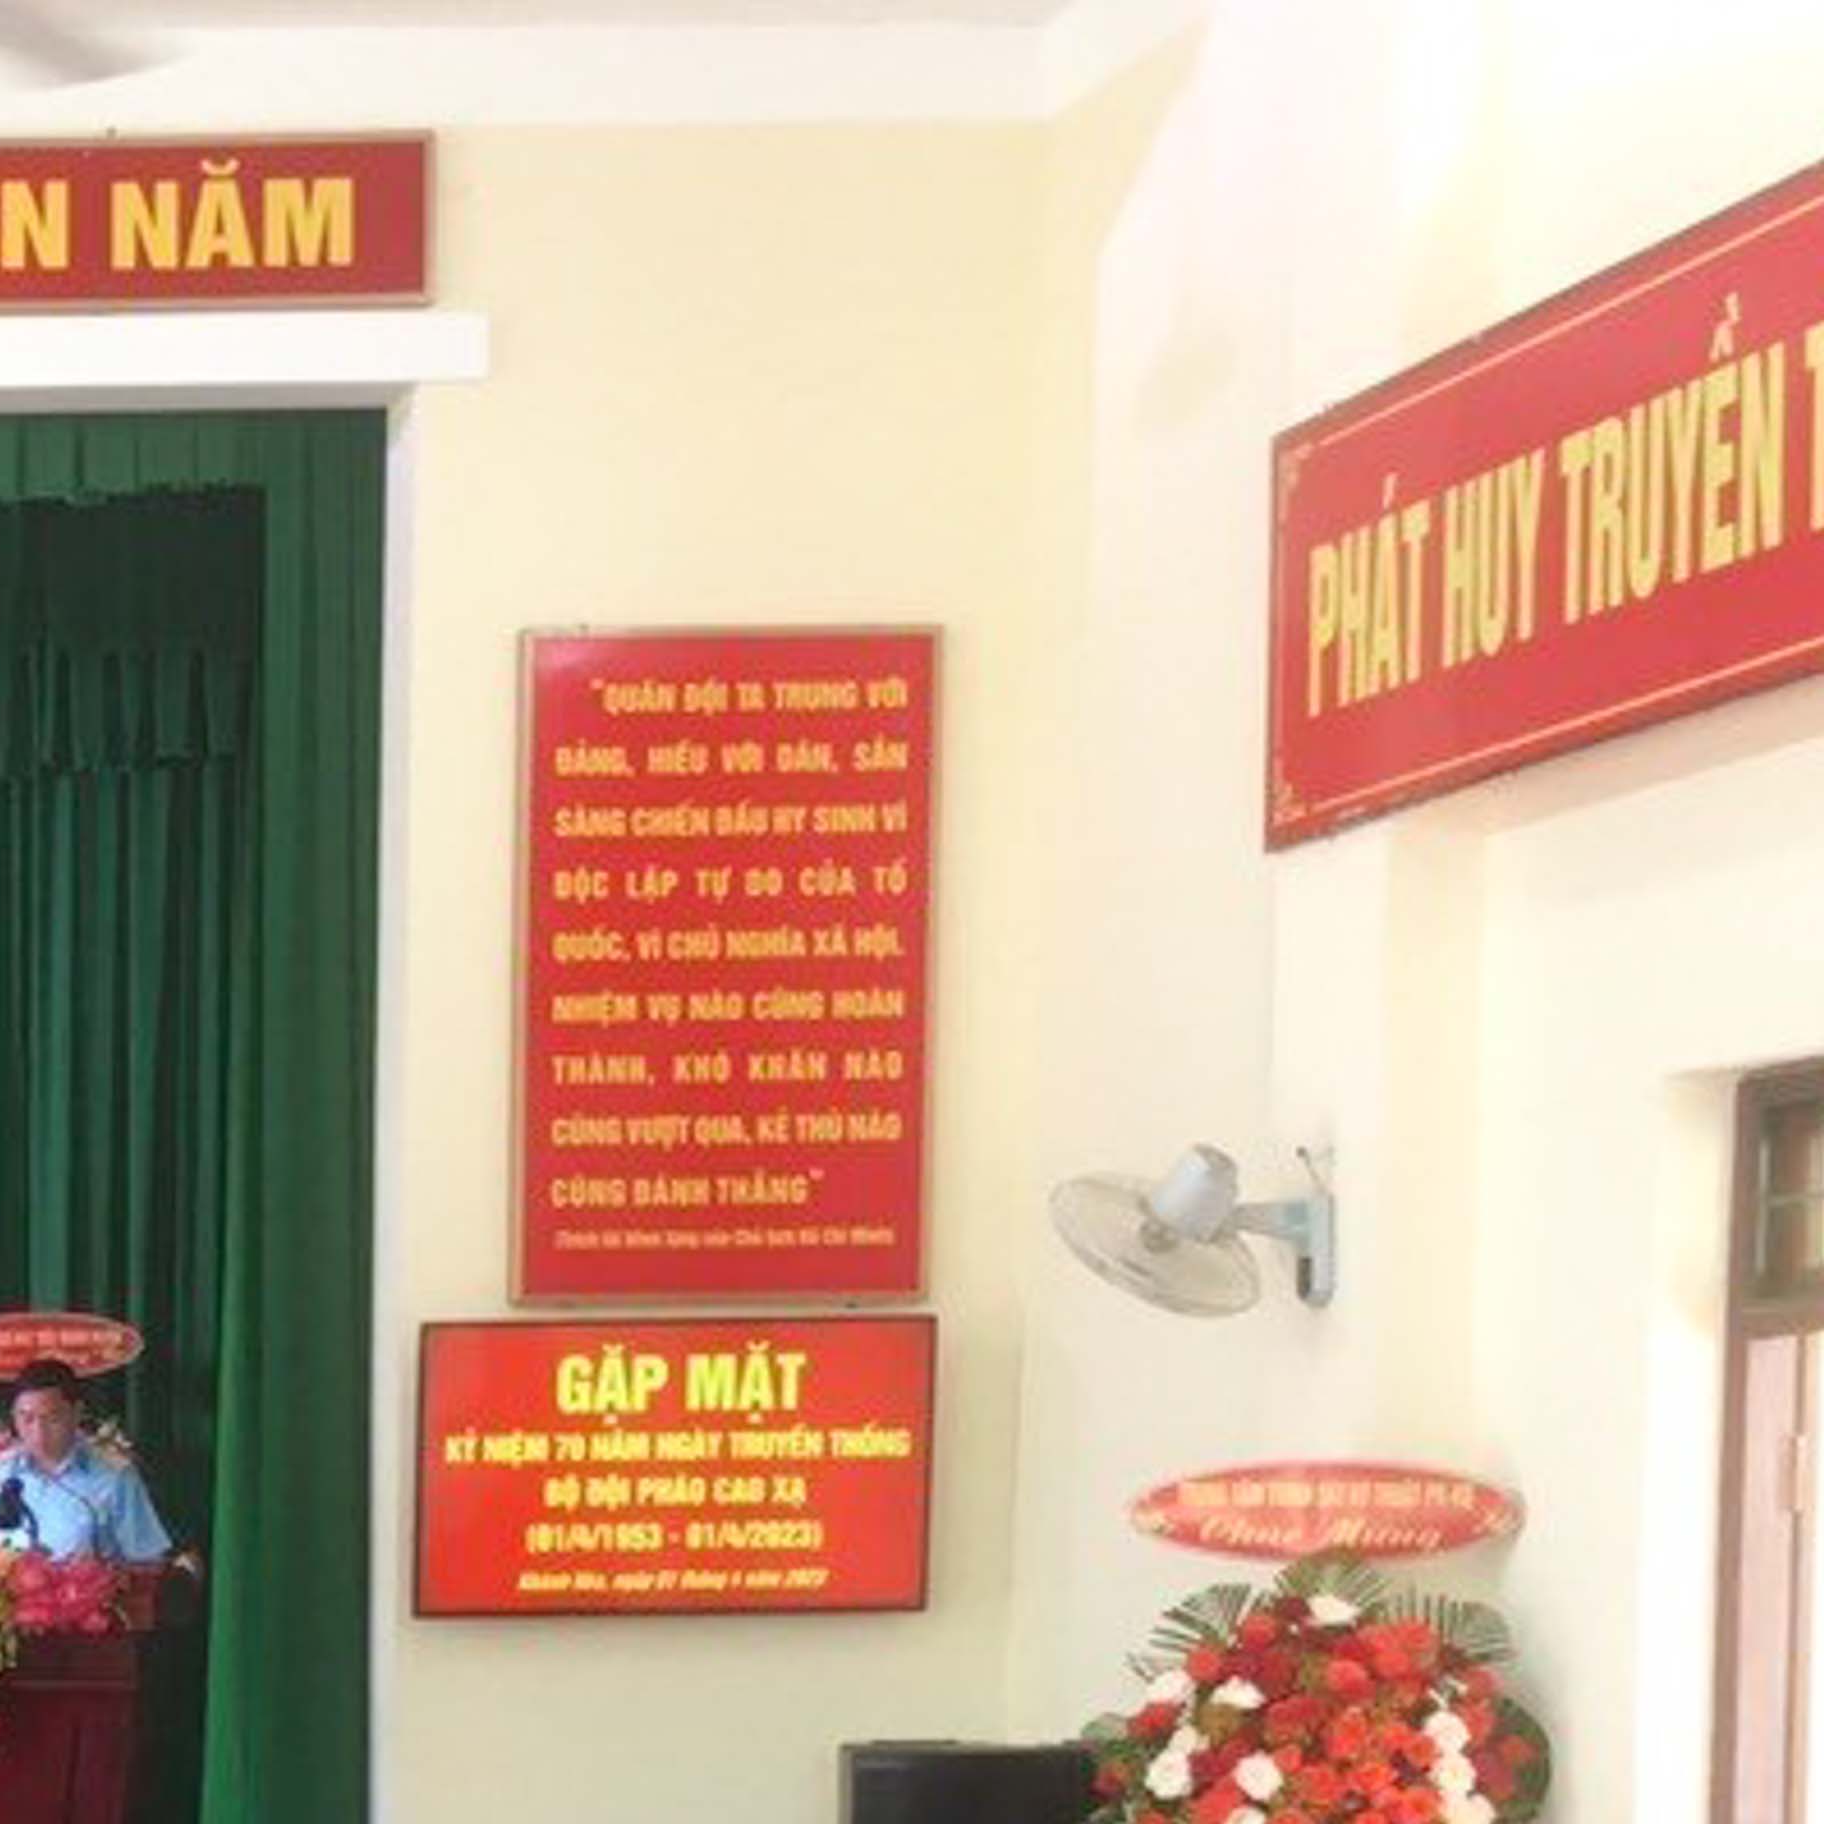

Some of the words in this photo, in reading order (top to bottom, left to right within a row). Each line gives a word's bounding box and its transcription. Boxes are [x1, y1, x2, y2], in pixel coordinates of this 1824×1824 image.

[111, 157, 355, 271] NĂM
[1308, 474, 1431, 719] PHÁT
[1443, 445, 1545, 668] HUY
[556, 1343, 669, 1425] GẶP
[685, 1342, 805, 1424] MẶT
